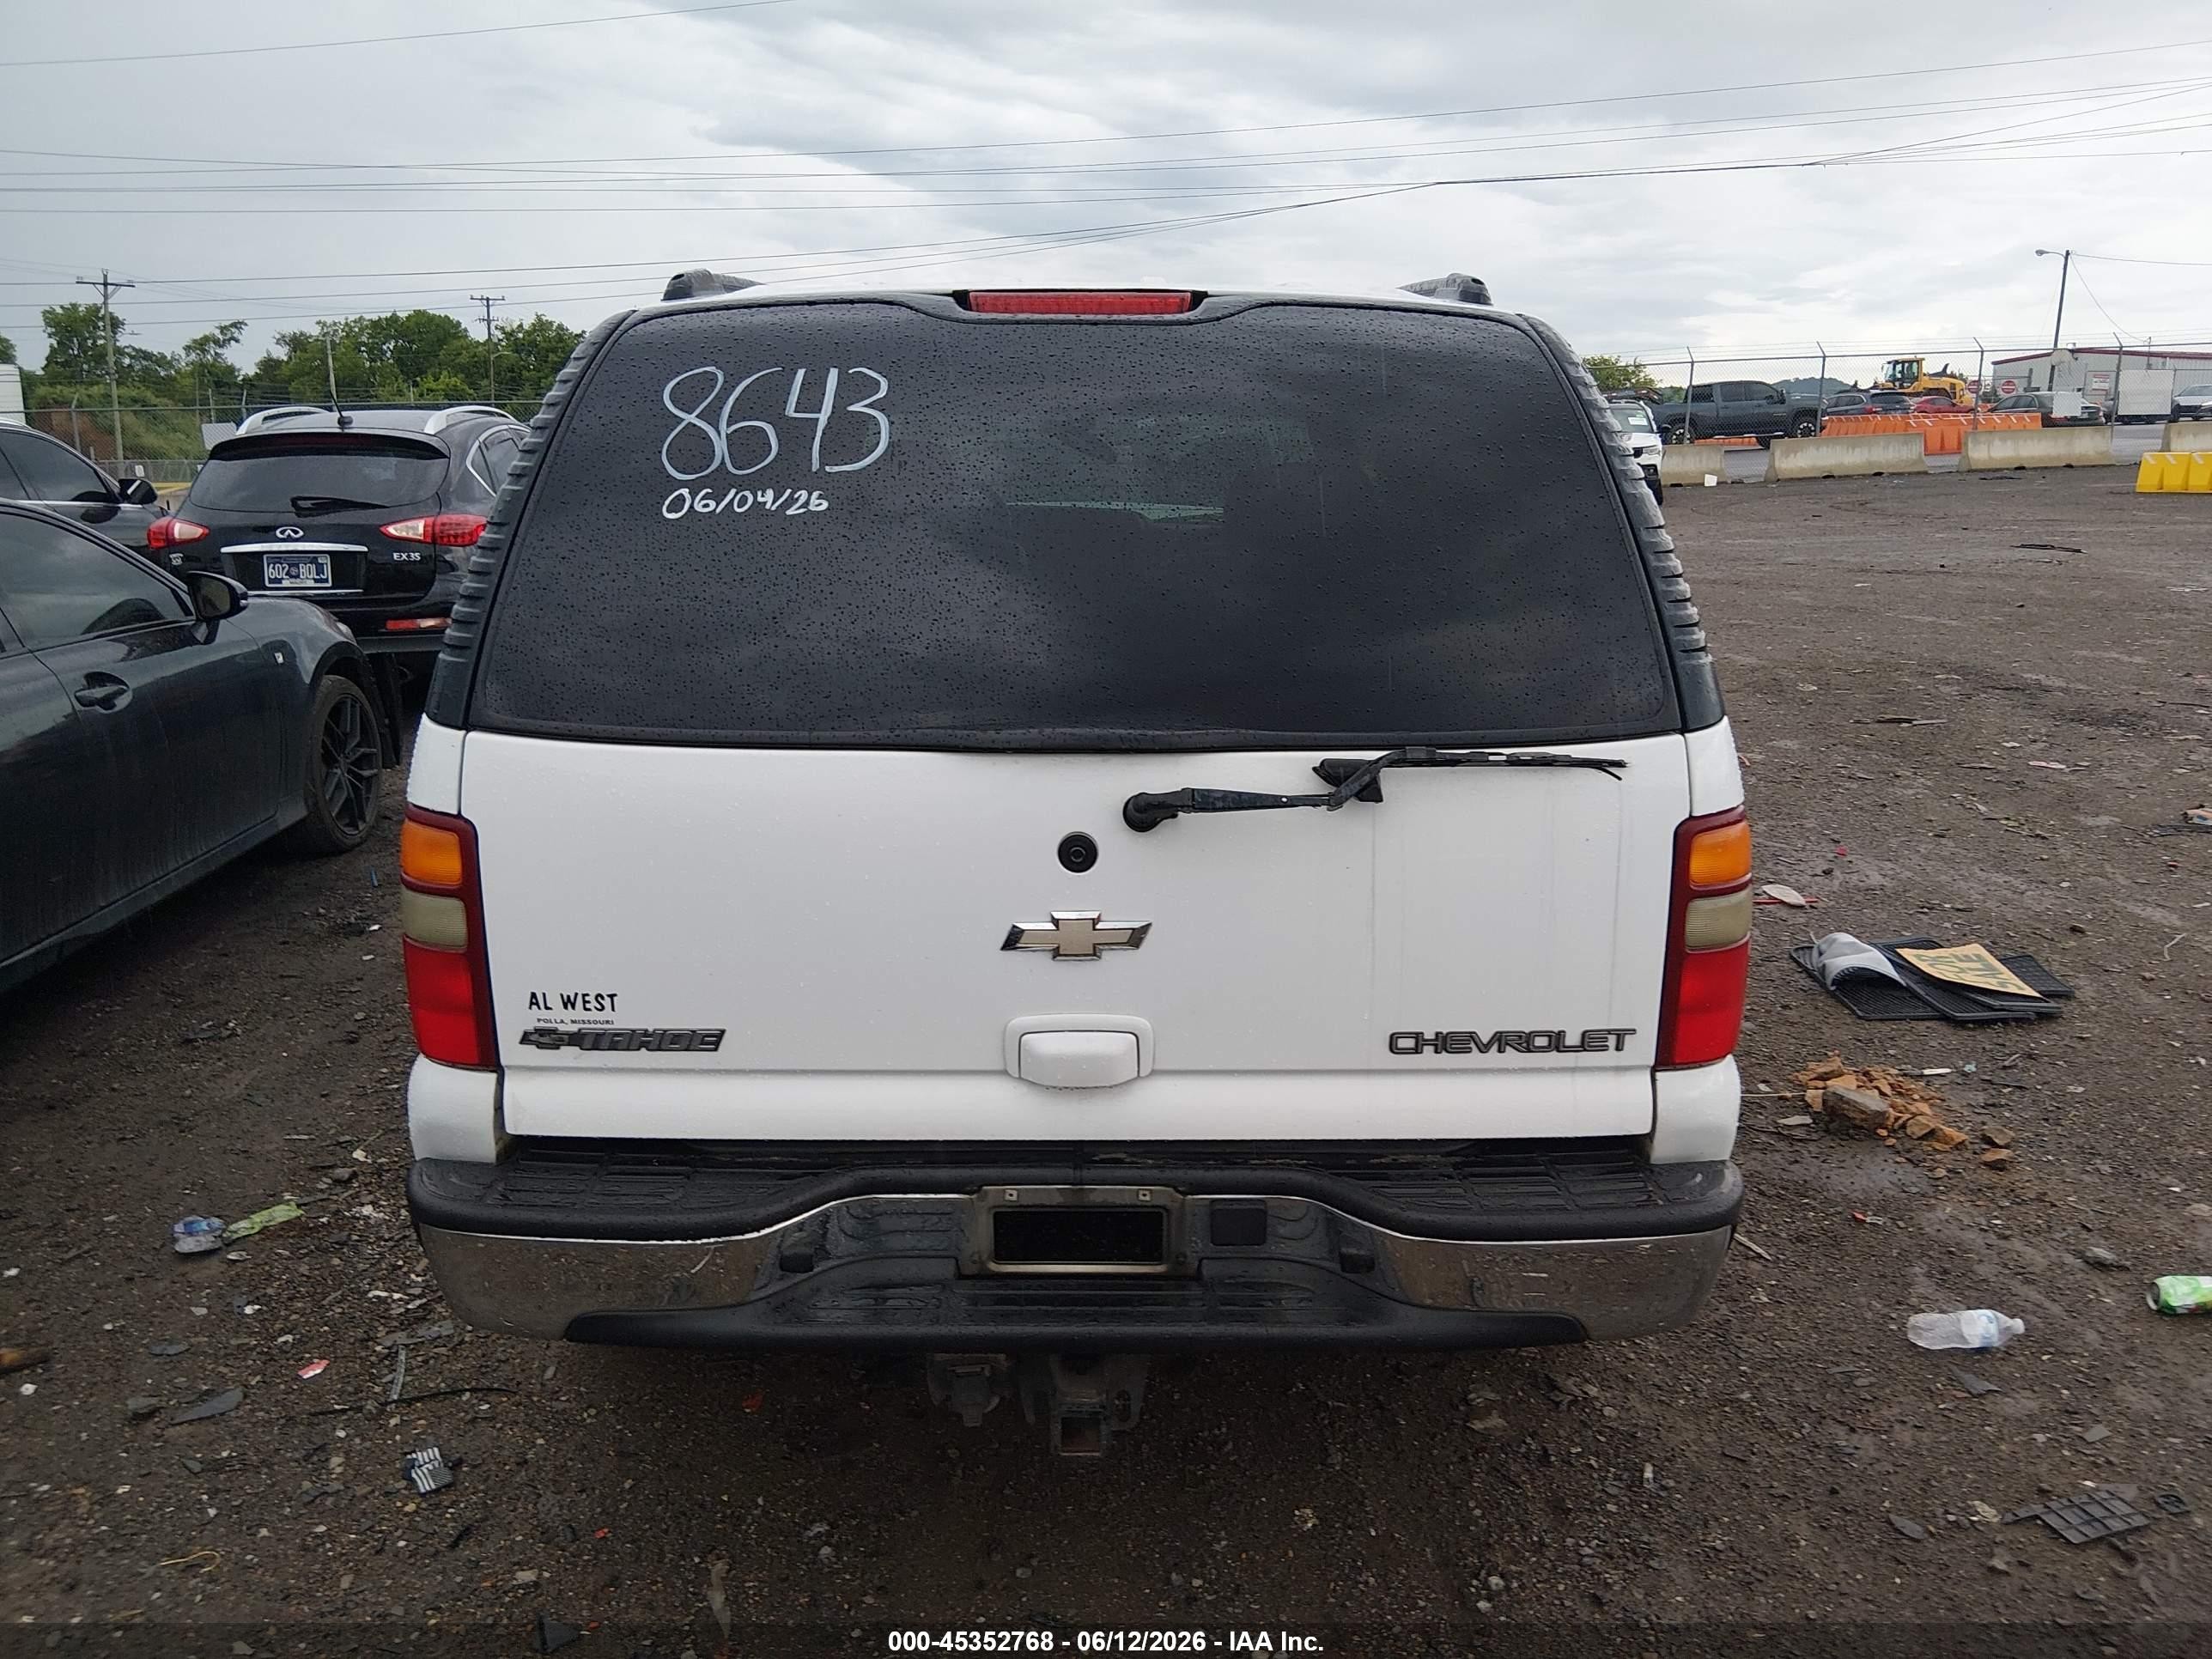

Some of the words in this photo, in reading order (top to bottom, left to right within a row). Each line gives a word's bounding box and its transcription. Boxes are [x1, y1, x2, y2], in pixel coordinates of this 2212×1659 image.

[661, 366, 890, 480] 8643
[662, 488, 829, 519] 06/04/26
[268, 563, 289, 579] 602
[528, 992, 553, 1011] AL
[560, 992, 618, 1012] WEST
[579, 1028, 726, 1052] TAHOE
[1389, 1029, 1637, 1054] CHEVROLET
